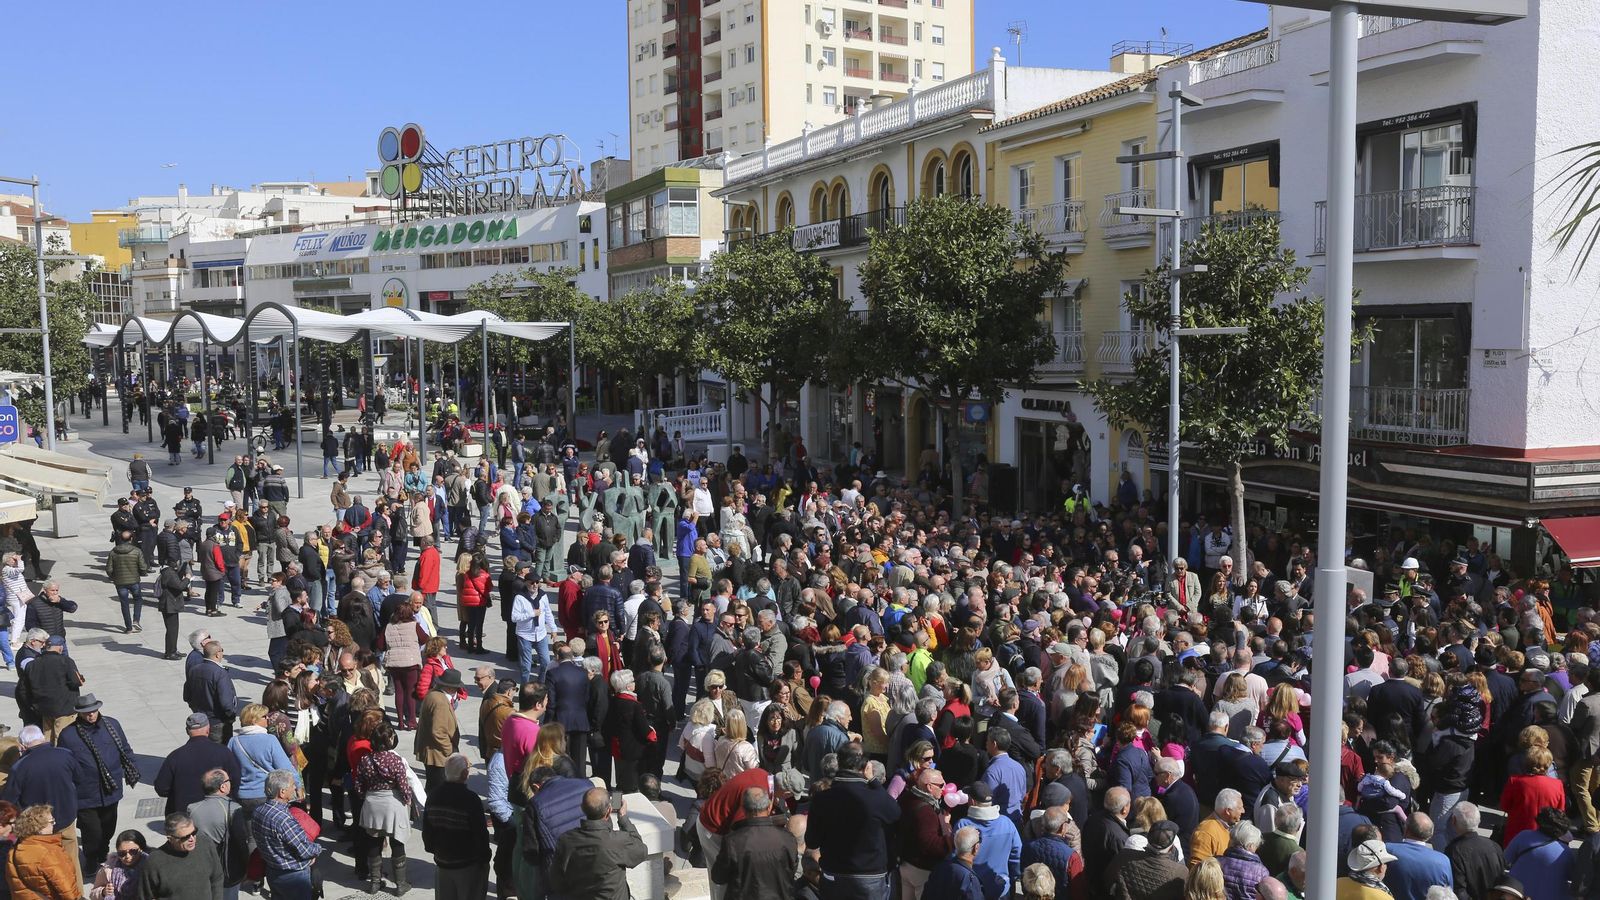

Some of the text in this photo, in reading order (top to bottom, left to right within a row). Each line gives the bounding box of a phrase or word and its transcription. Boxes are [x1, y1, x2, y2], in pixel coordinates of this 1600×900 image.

[444, 133, 562, 180] CENTRO
[428, 164, 585, 219] ENTREPLAZAS
[329, 231, 367, 252] MUÑOZ
[373, 216, 518, 251] MERCADONA
